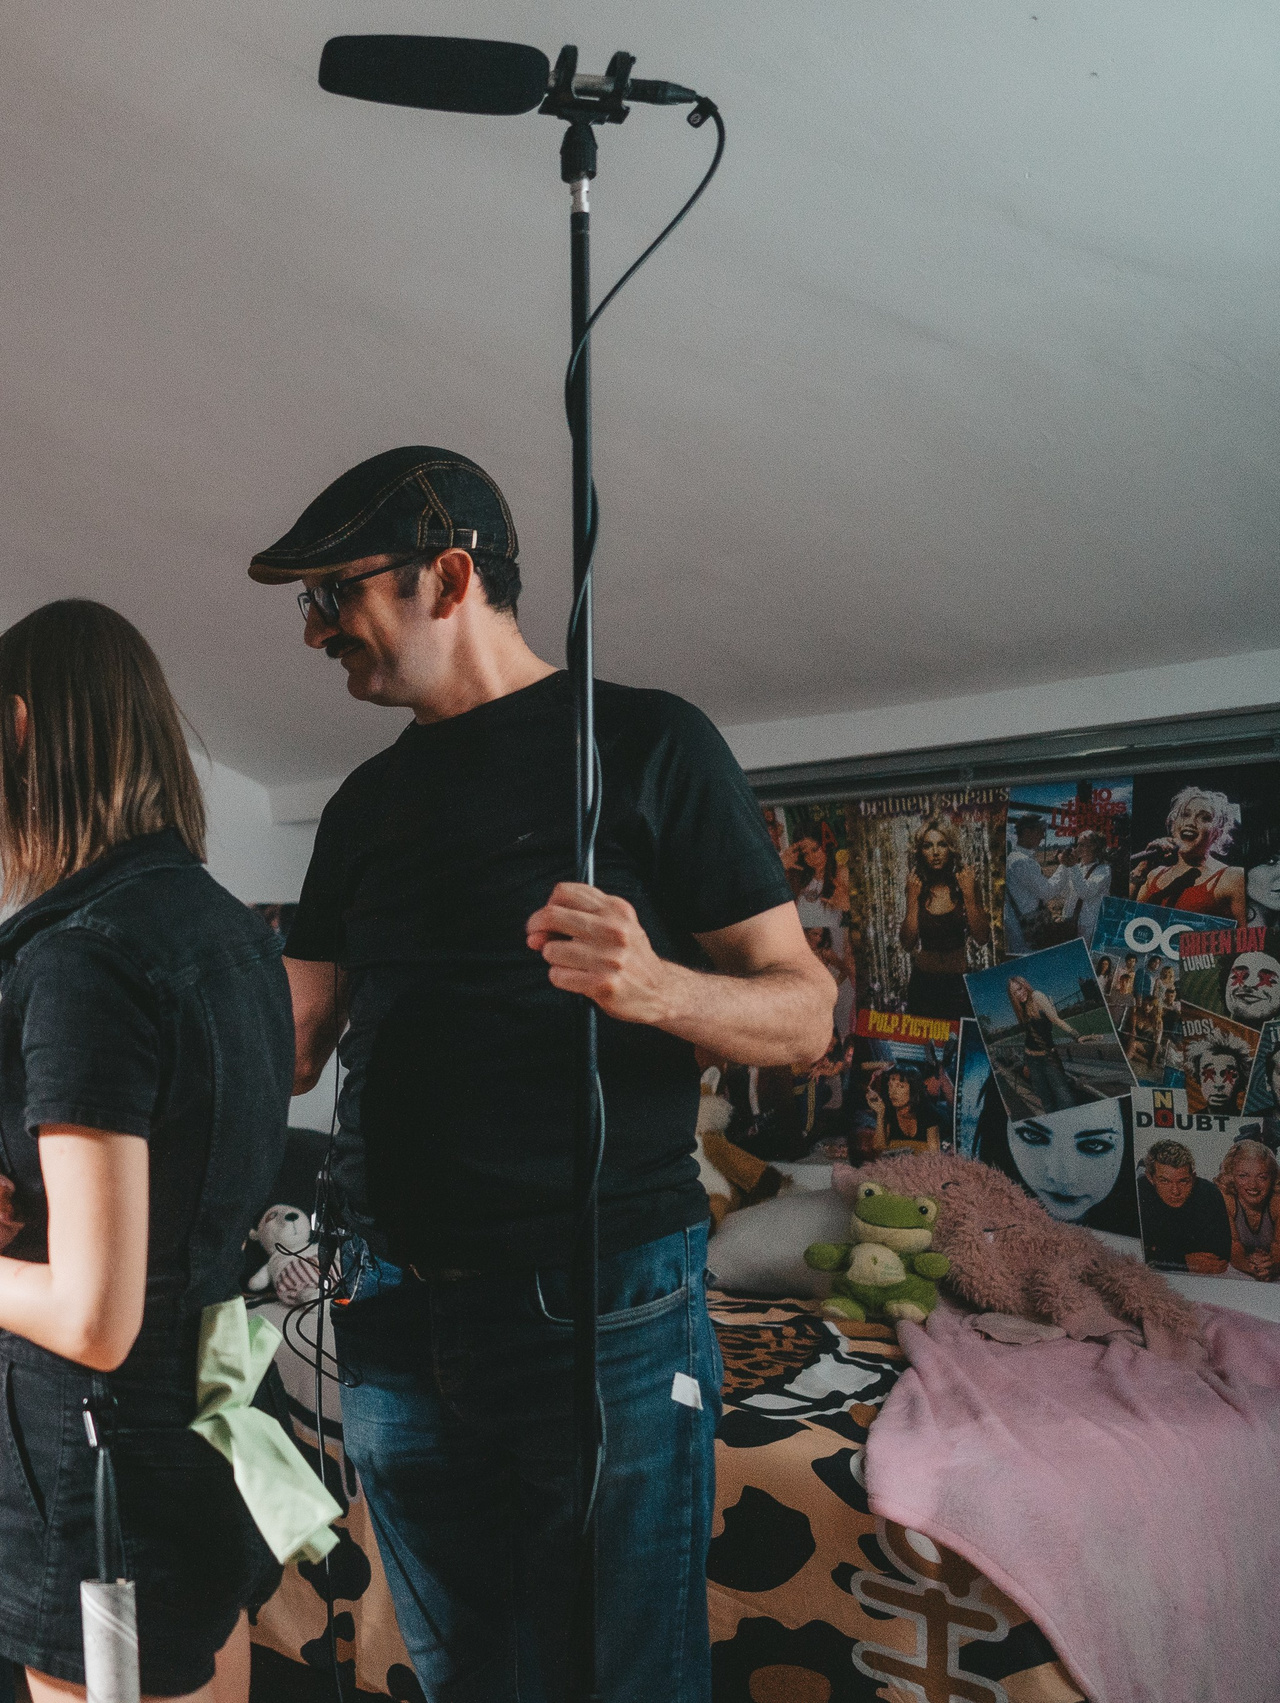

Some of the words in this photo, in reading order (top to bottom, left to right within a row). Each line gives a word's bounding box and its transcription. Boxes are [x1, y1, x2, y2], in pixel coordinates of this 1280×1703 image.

[1180, 928, 1231, 958] GREEN
[1236, 925, 1267, 953] DAY
[868, 1009, 900, 1034] PULP
[900, 1013, 951, 1041] FICTION
